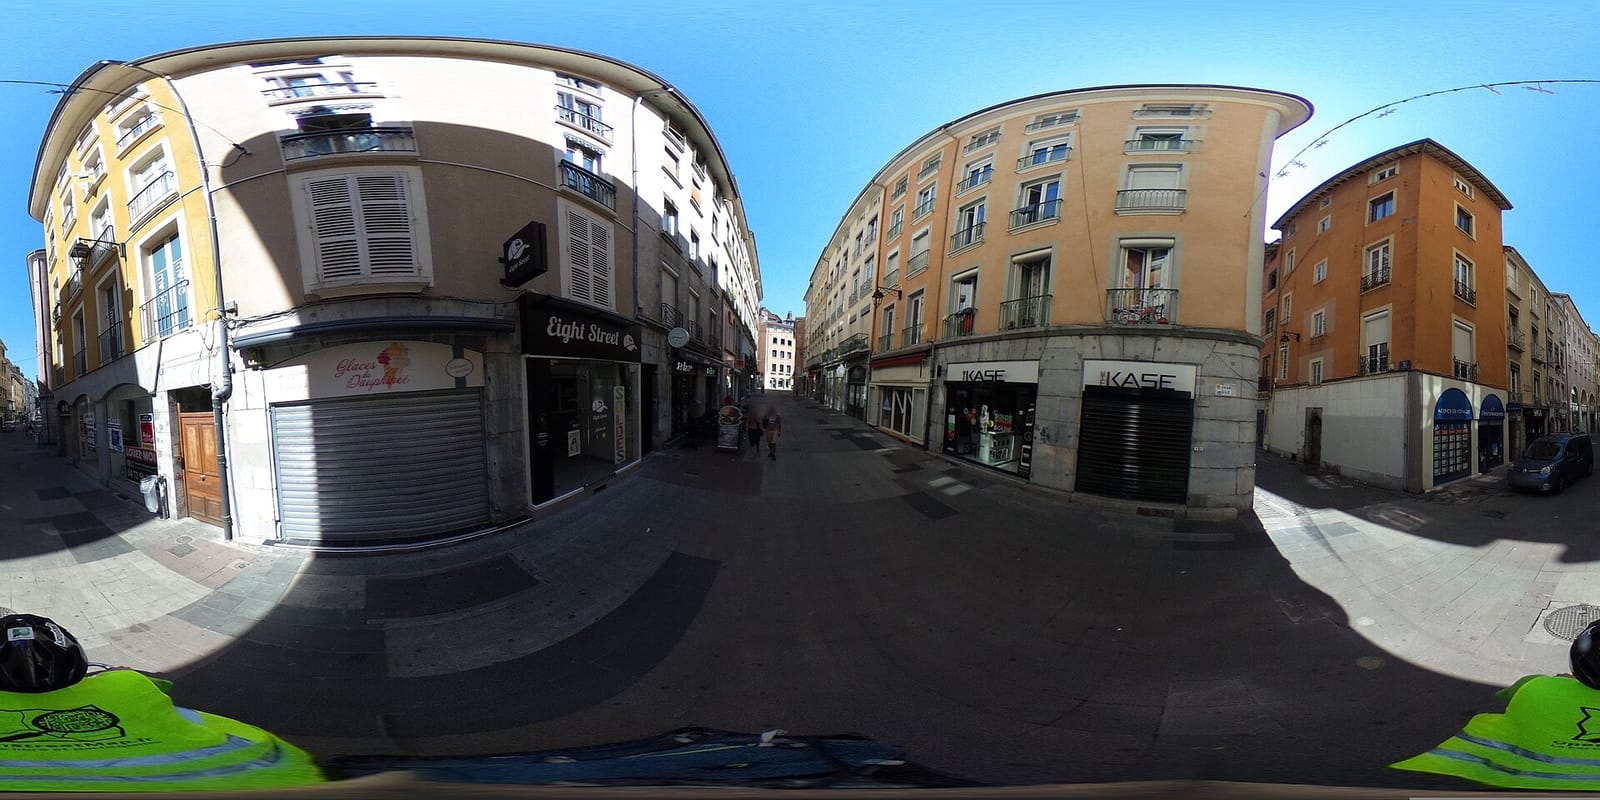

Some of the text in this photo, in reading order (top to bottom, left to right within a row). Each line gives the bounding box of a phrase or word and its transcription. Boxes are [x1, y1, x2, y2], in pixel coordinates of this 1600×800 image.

[546, 316, 619, 346] Eight Street
[335, 358, 377, 379] Glaces
[1106, 371, 1177, 391] KASE
